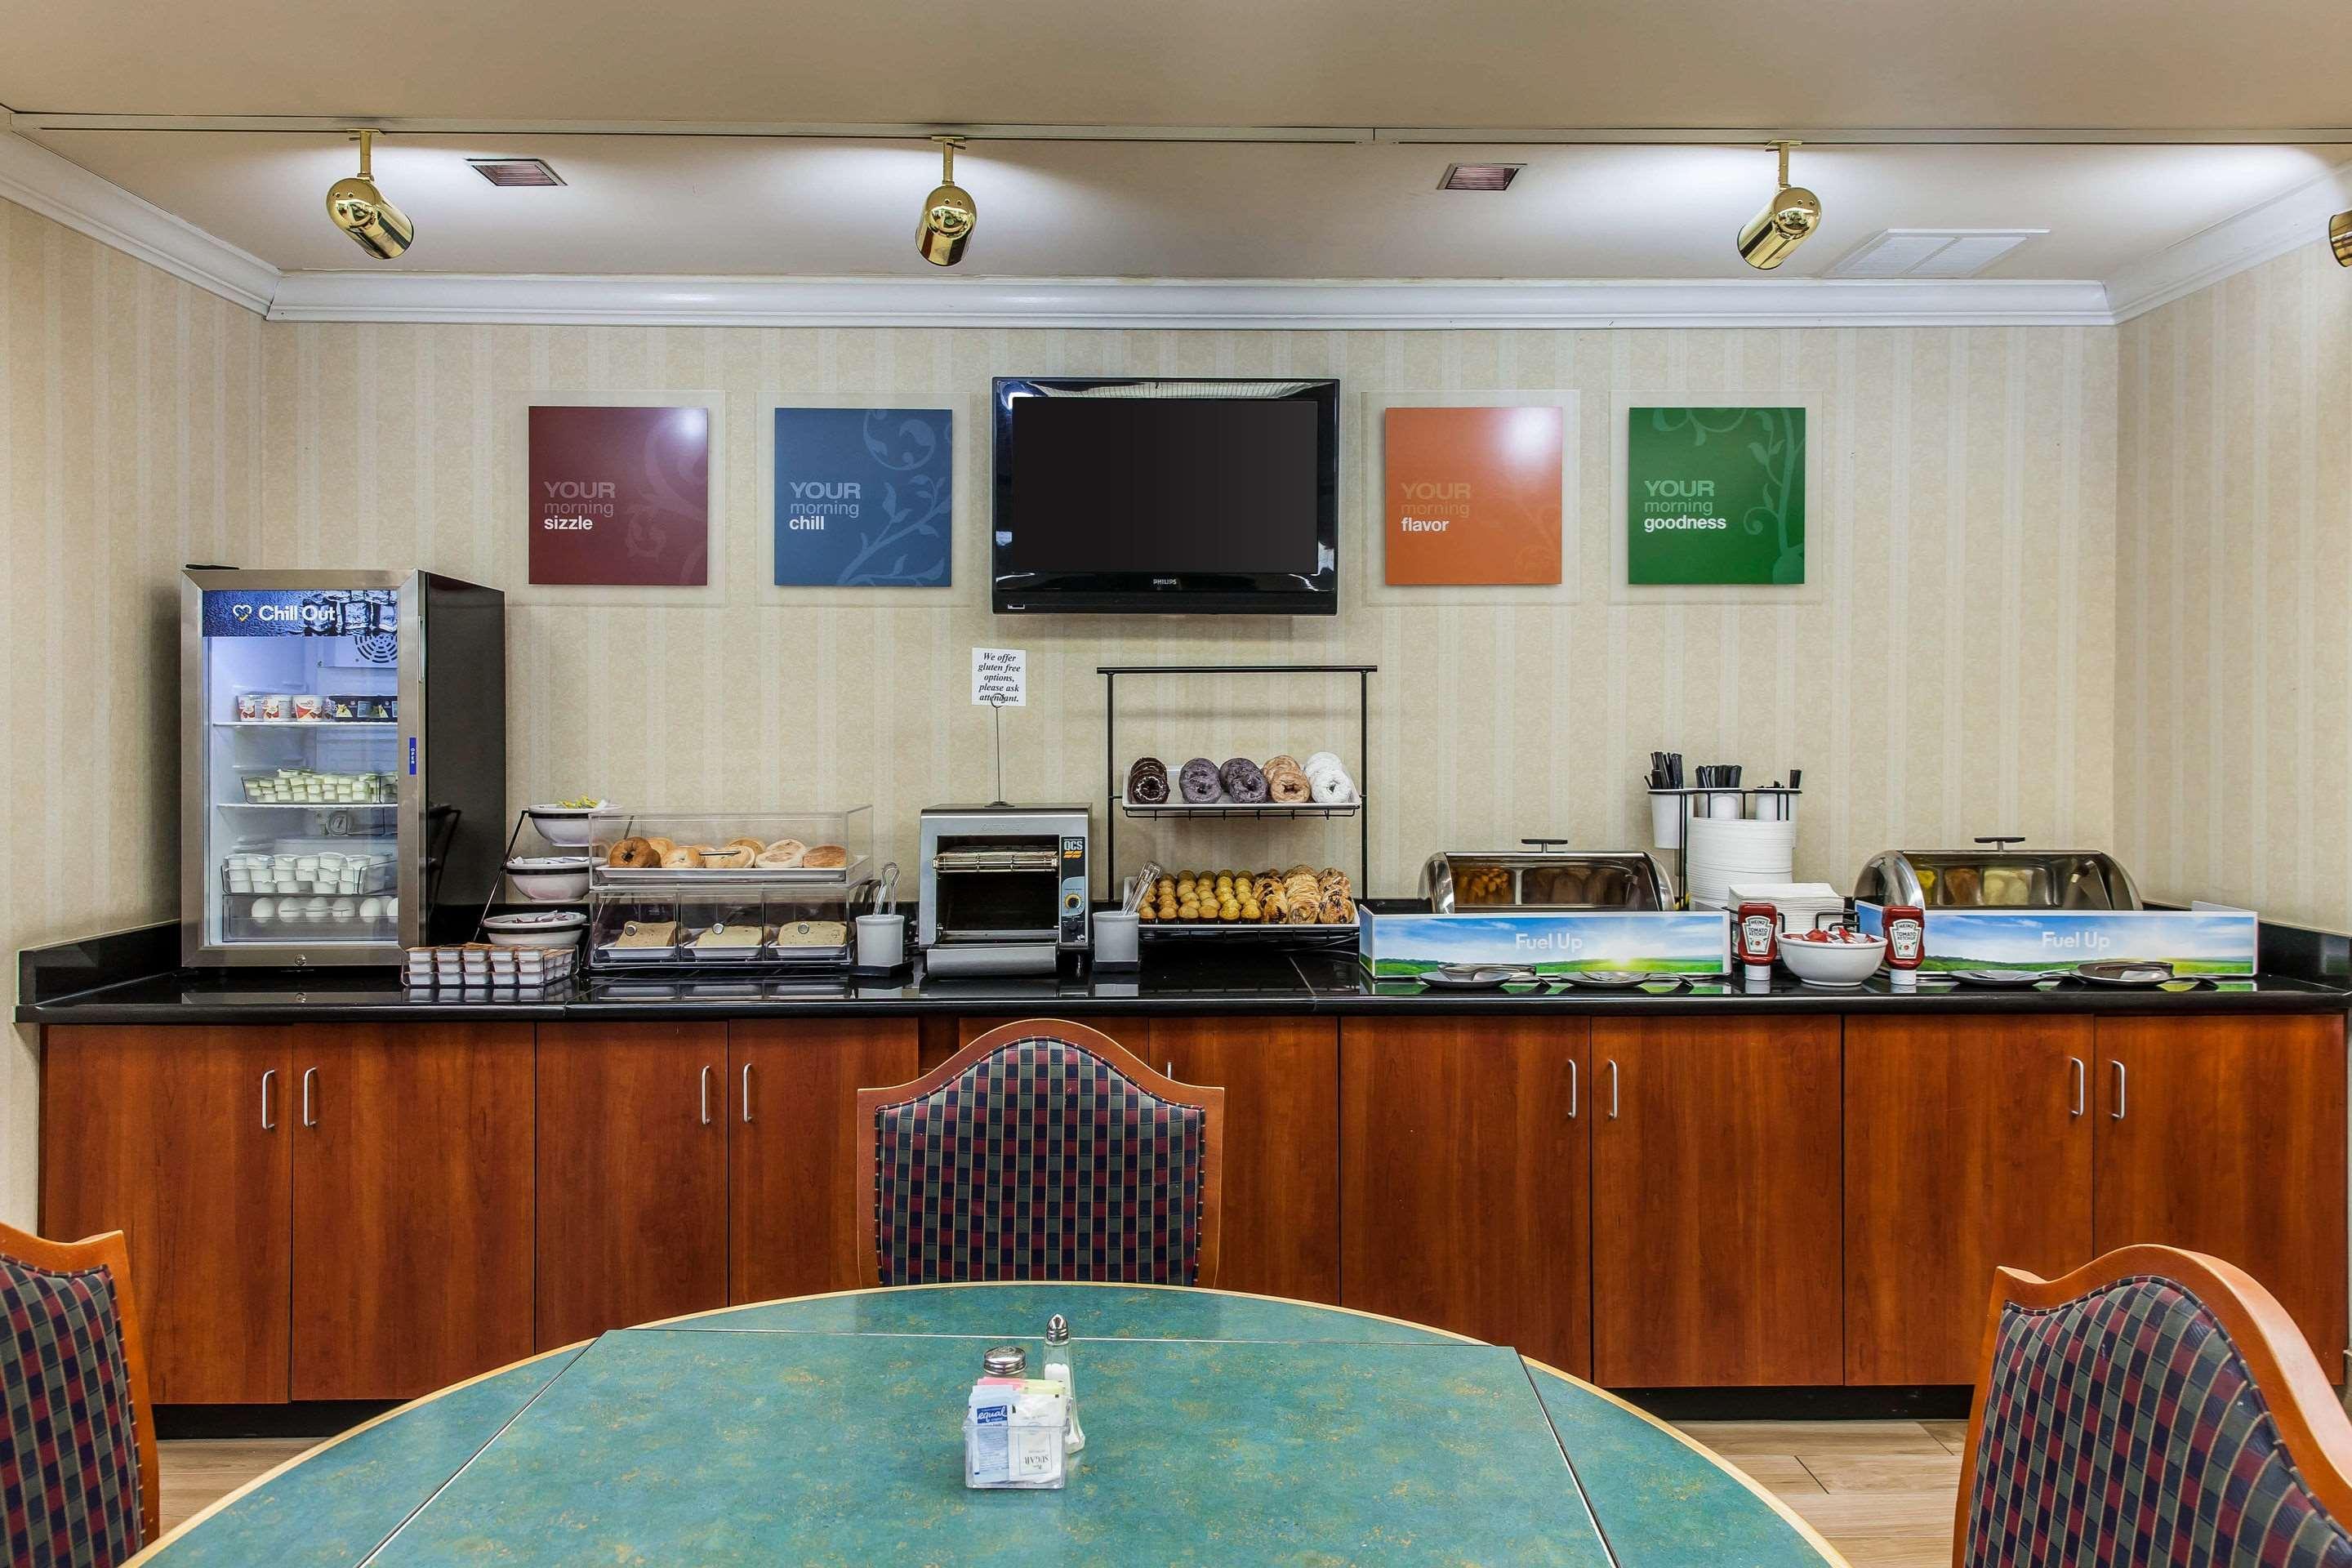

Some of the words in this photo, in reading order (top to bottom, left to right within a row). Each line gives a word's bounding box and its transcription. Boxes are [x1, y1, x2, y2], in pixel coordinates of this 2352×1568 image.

[544, 481, 616, 499] YOUR
[790, 482, 861, 500] YOUR
[1401, 483, 1471, 500] YOUR
[1645, 479, 1715, 497] YOUR
[544, 500, 614, 518] morning
[790, 500, 859, 519] morning
[1401, 501, 1470, 519] morning
[1644, 498, 1713, 516] morning
[544, 514, 593, 530] sizzle
[789, 515, 825, 530] chill
[1401, 516, 1450, 532] flavor
[1644, 514, 1726, 532] goodness
[259, 604, 298, 621] Chill
[302, 604, 336, 621] Out
[983, 653, 996, 661] We
[997, 653, 1017, 663] offer
[978, 662, 1003, 672] gluten
[1004, 664, 1021, 674] free
[983, 673, 1014, 683] options,
[978, 683, 1004, 693] please
[1005, 684, 1019, 693] ask
[1516, 933, 1552, 949] Fuel
[1557, 933, 1583, 953] Up
[2042, 931, 2080, 948] Fuel
[2085, 931, 2111, 952] Up
[978, 1405, 1007, 1423] equal
[1024, 1455, 1049, 1464] SUGAR
